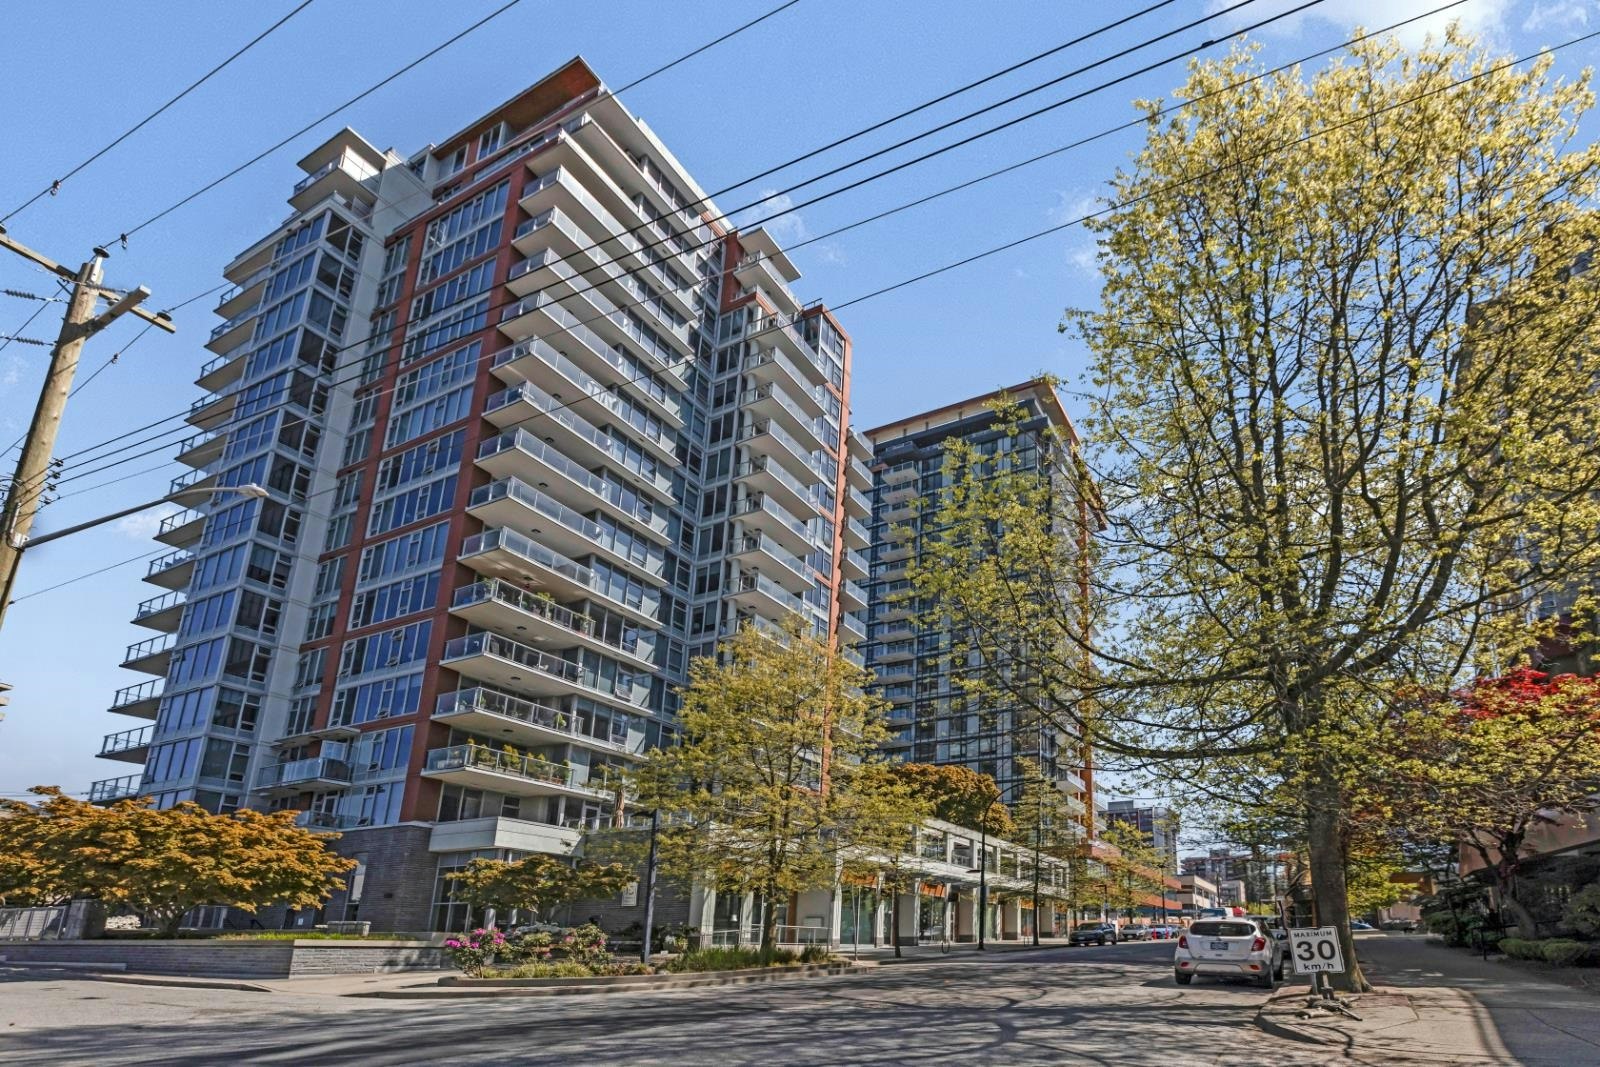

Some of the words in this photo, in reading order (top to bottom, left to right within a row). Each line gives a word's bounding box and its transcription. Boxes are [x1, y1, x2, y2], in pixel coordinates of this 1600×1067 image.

[1293, 930, 1332, 938] MAXIMUM
[1296, 939, 1336, 961] 30
[1303, 963, 1335, 971] km/h
